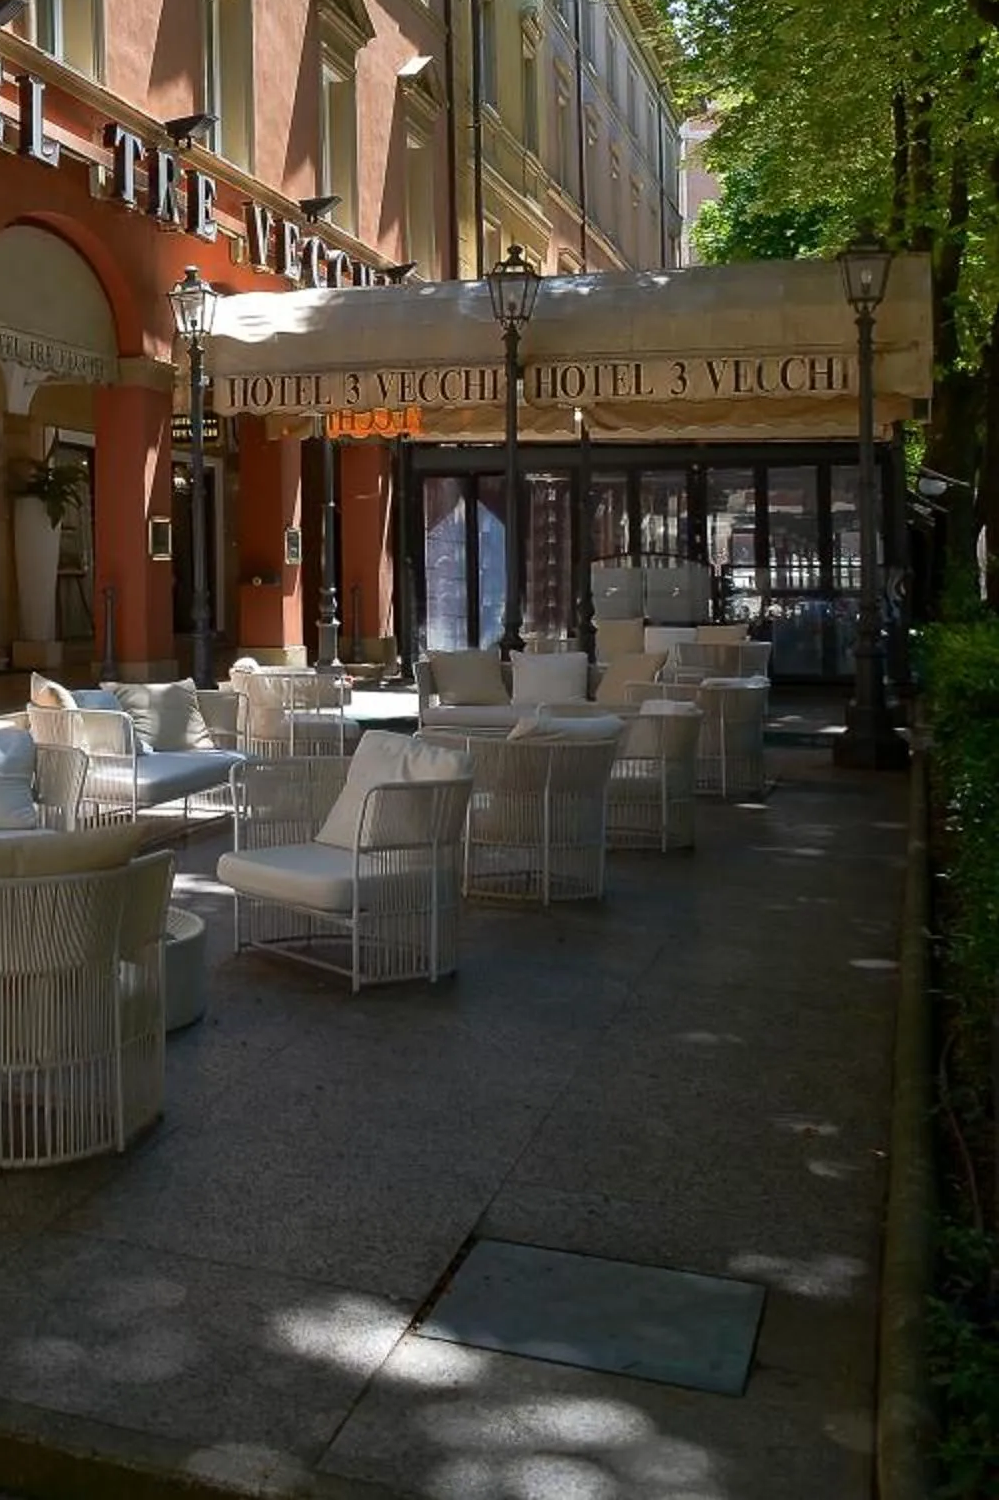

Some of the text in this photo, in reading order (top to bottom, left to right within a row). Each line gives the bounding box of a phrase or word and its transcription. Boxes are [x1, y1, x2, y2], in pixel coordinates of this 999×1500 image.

[103, 122, 217, 243] TRE
[226, 368, 499, 407] HOTEL 3 VECCHI
[535, 356, 849, 399] HOTEL 3 VECCHI
